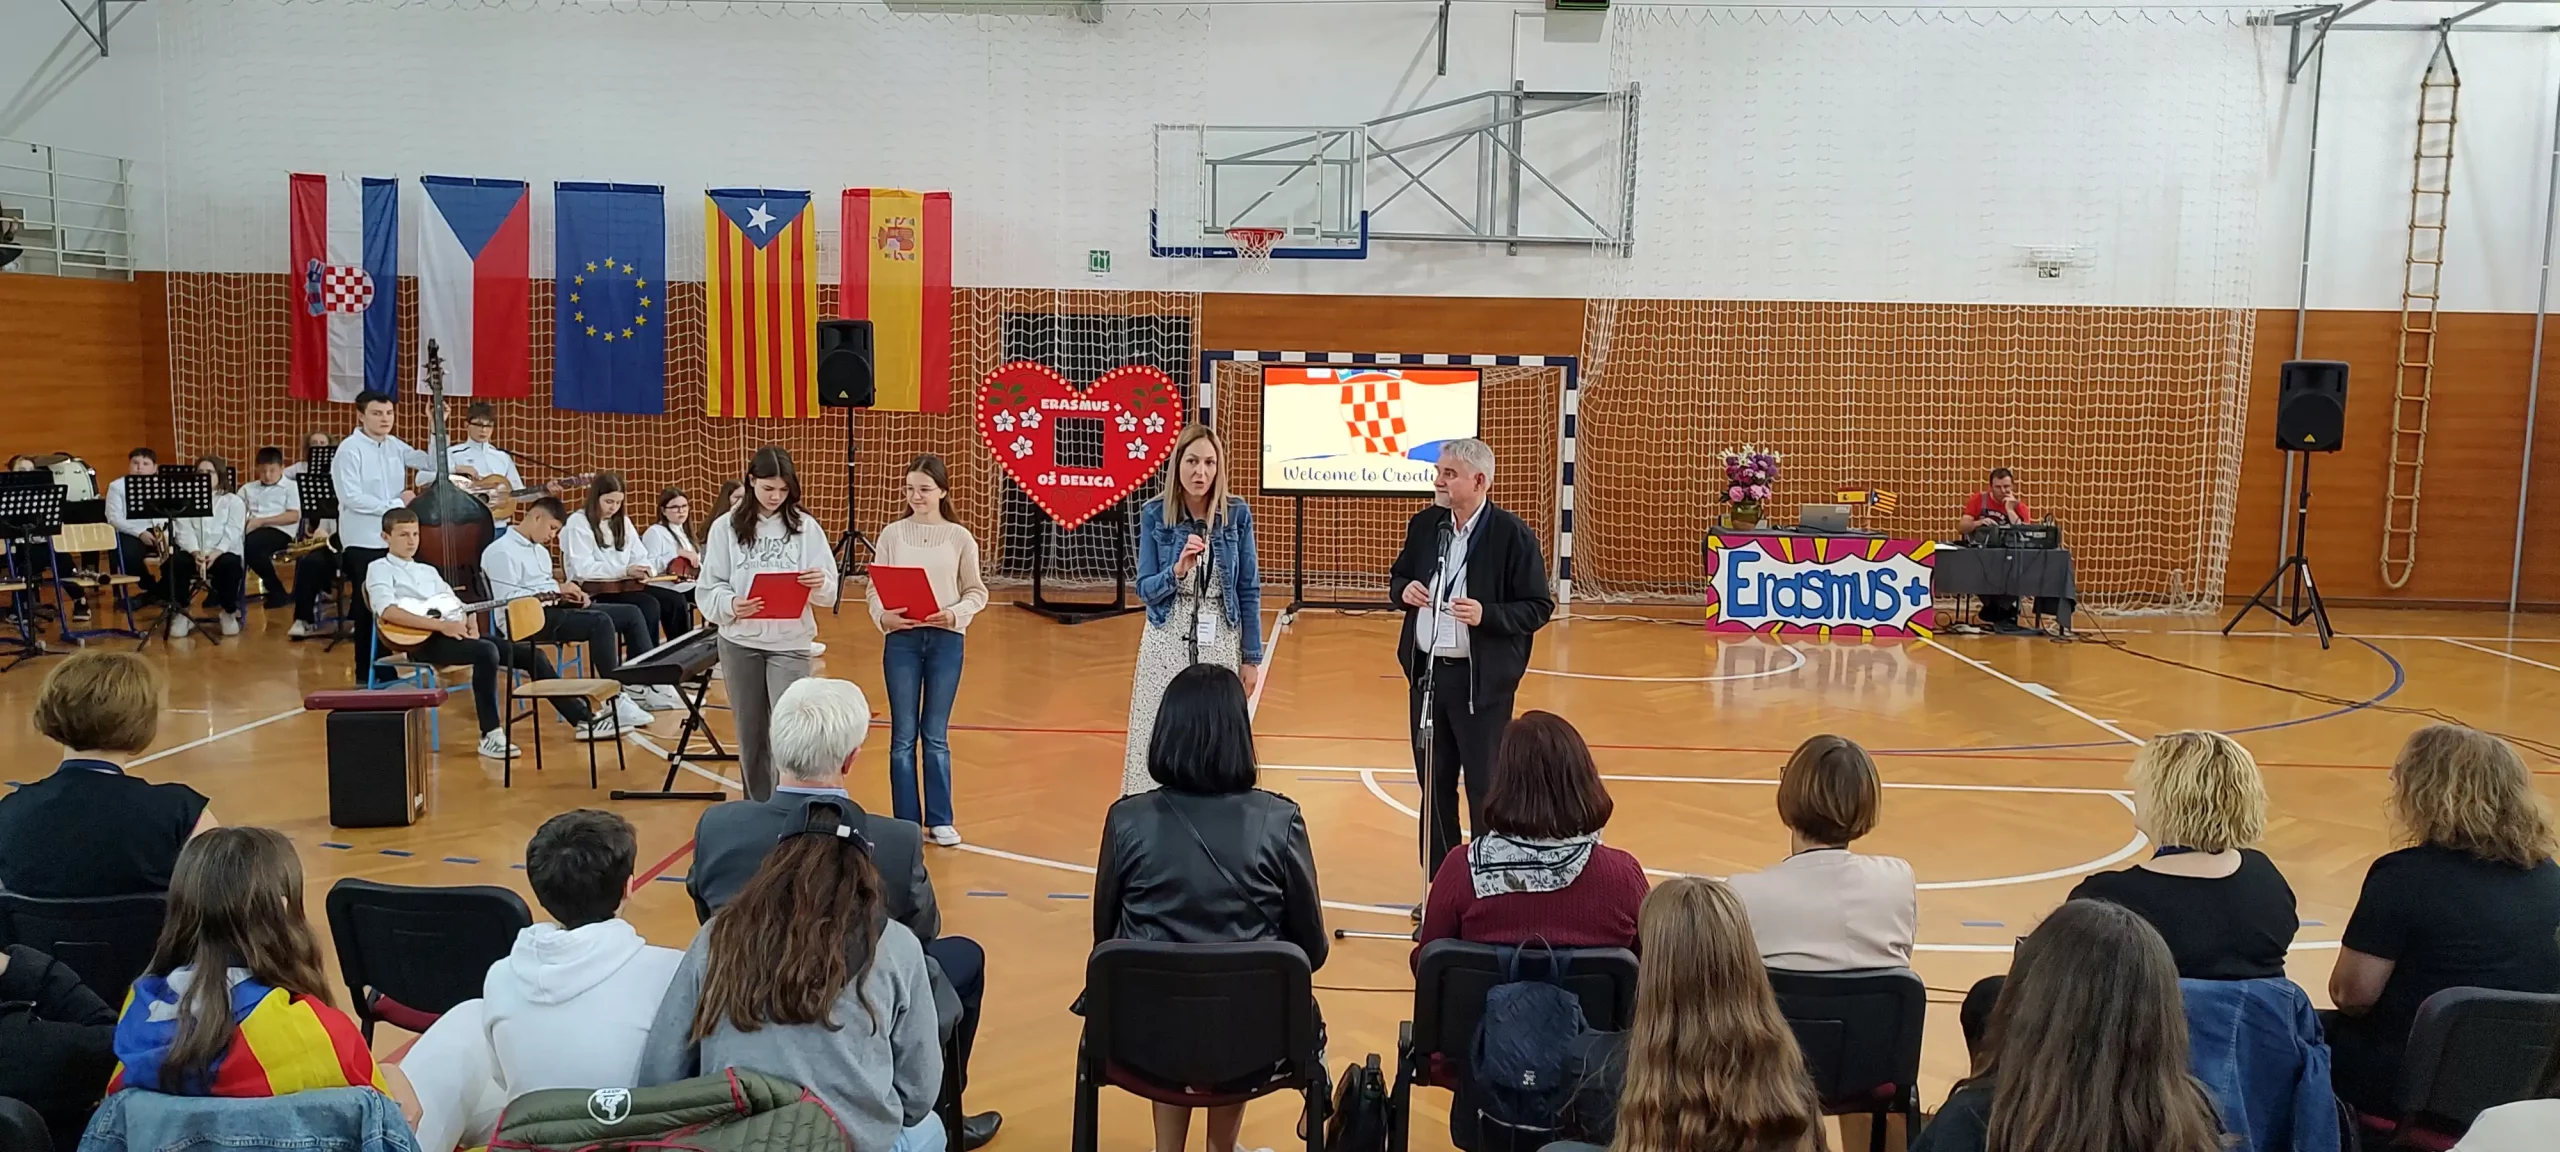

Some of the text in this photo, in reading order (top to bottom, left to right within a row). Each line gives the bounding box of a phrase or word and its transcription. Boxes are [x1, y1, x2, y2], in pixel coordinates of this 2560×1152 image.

[1041, 399, 1110, 412] ERASMUS
[1037, 471, 1115, 488] OŠ BELICA
[1283, 466, 1435, 482] Welcome to Croati
[743, 561, 791, 570] ORIGINALS
[1727, 550, 1929, 622] Erasmus+
